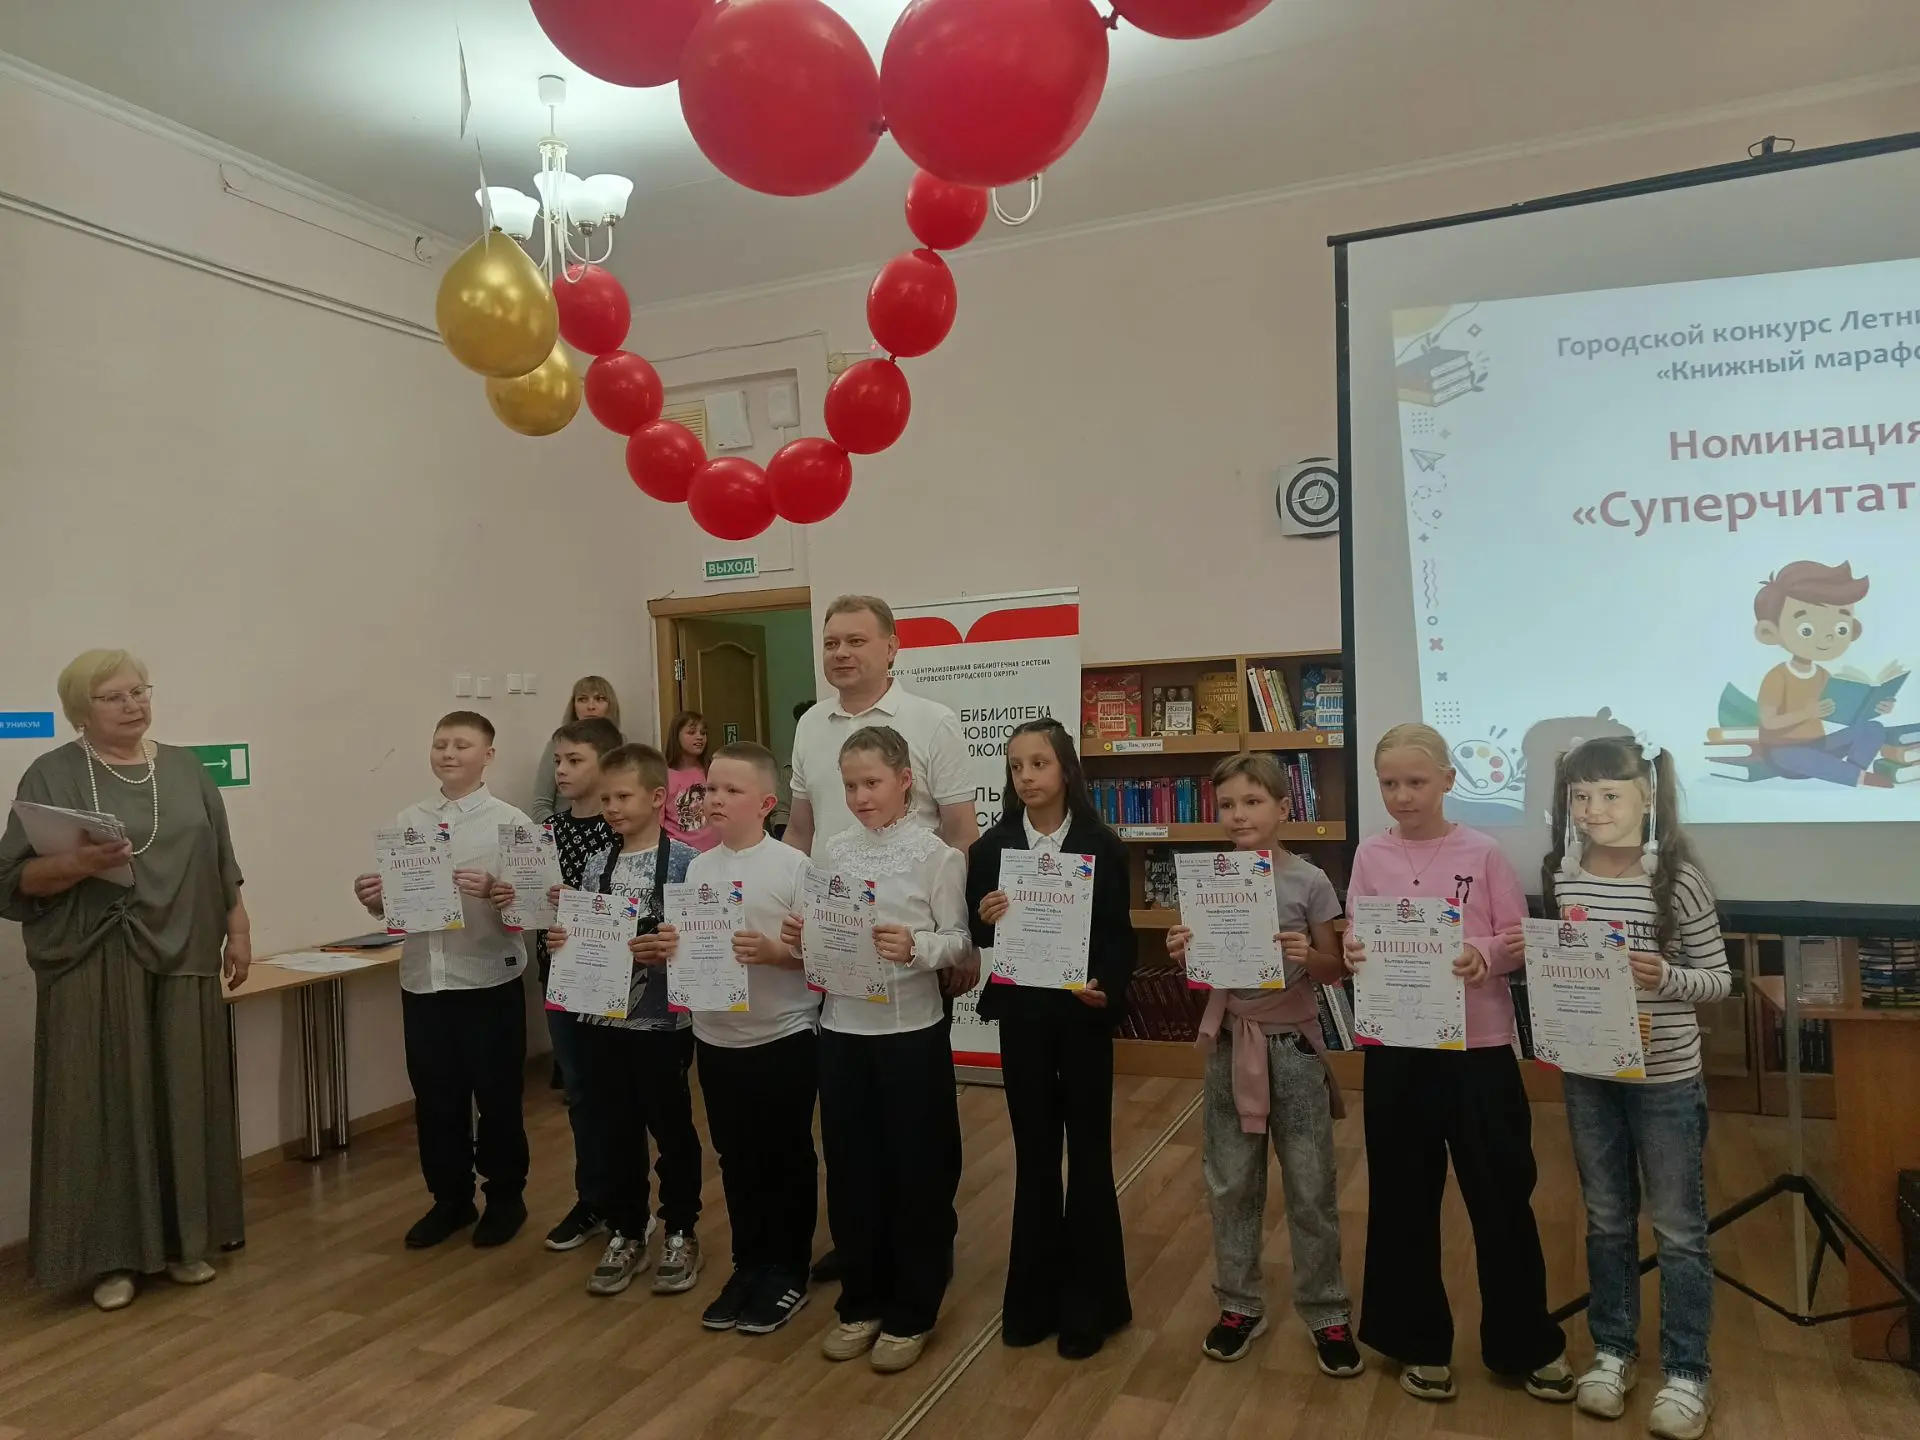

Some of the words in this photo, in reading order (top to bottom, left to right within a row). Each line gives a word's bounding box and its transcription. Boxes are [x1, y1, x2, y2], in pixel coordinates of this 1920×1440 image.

[1557, 323, 1704, 360] Городской
[1713, 317, 1833, 343] конкурс
[1840, 309, 1920, 332] Летн
[1657, 349, 1805, 381] «Книжный
[1670, 420, 1920, 460] Номинация
[708, 560, 753, 574] ВЫХОД
[911, 664, 971, 675] ЦЕНТРАЛИЗОВАННАЯ
[973, 661, 1019, 671] БИБЛИОТЕЧНАЯ
[1021, 659, 1051, 667] СИСТЕМА
[916, 674, 952, 683] СЕРОВСКОГО
[953, 672, 992, 680] ГОРОДСКОГО
[960, 705, 1052, 722] БИБЛИОТЕКА
[968, 743, 1008, 757] ОКОЛЕ
[974, 787, 1001, 802] ЛЬ
[976, 811, 1002, 827] СК
[390, 856, 441, 870] ДИПЛОМ
[506, 857, 546, 867] ДИПЛОМ
[1013, 889, 1075, 905] ДИПЛОМ
[1195, 892, 1258, 906] ДИПЛОМ
[812, 908, 864, 928] ДИПЛОМ
[568, 926, 621, 941] ДИПЛОМ
[679, 920, 731, 933] ДИПЛОМ
[1371, 940, 1443, 954] ДИПЛОМ
[1541, 964, 1610, 980] ДИПЛОМ
[956, 1002, 976, 1012] ПОБ
